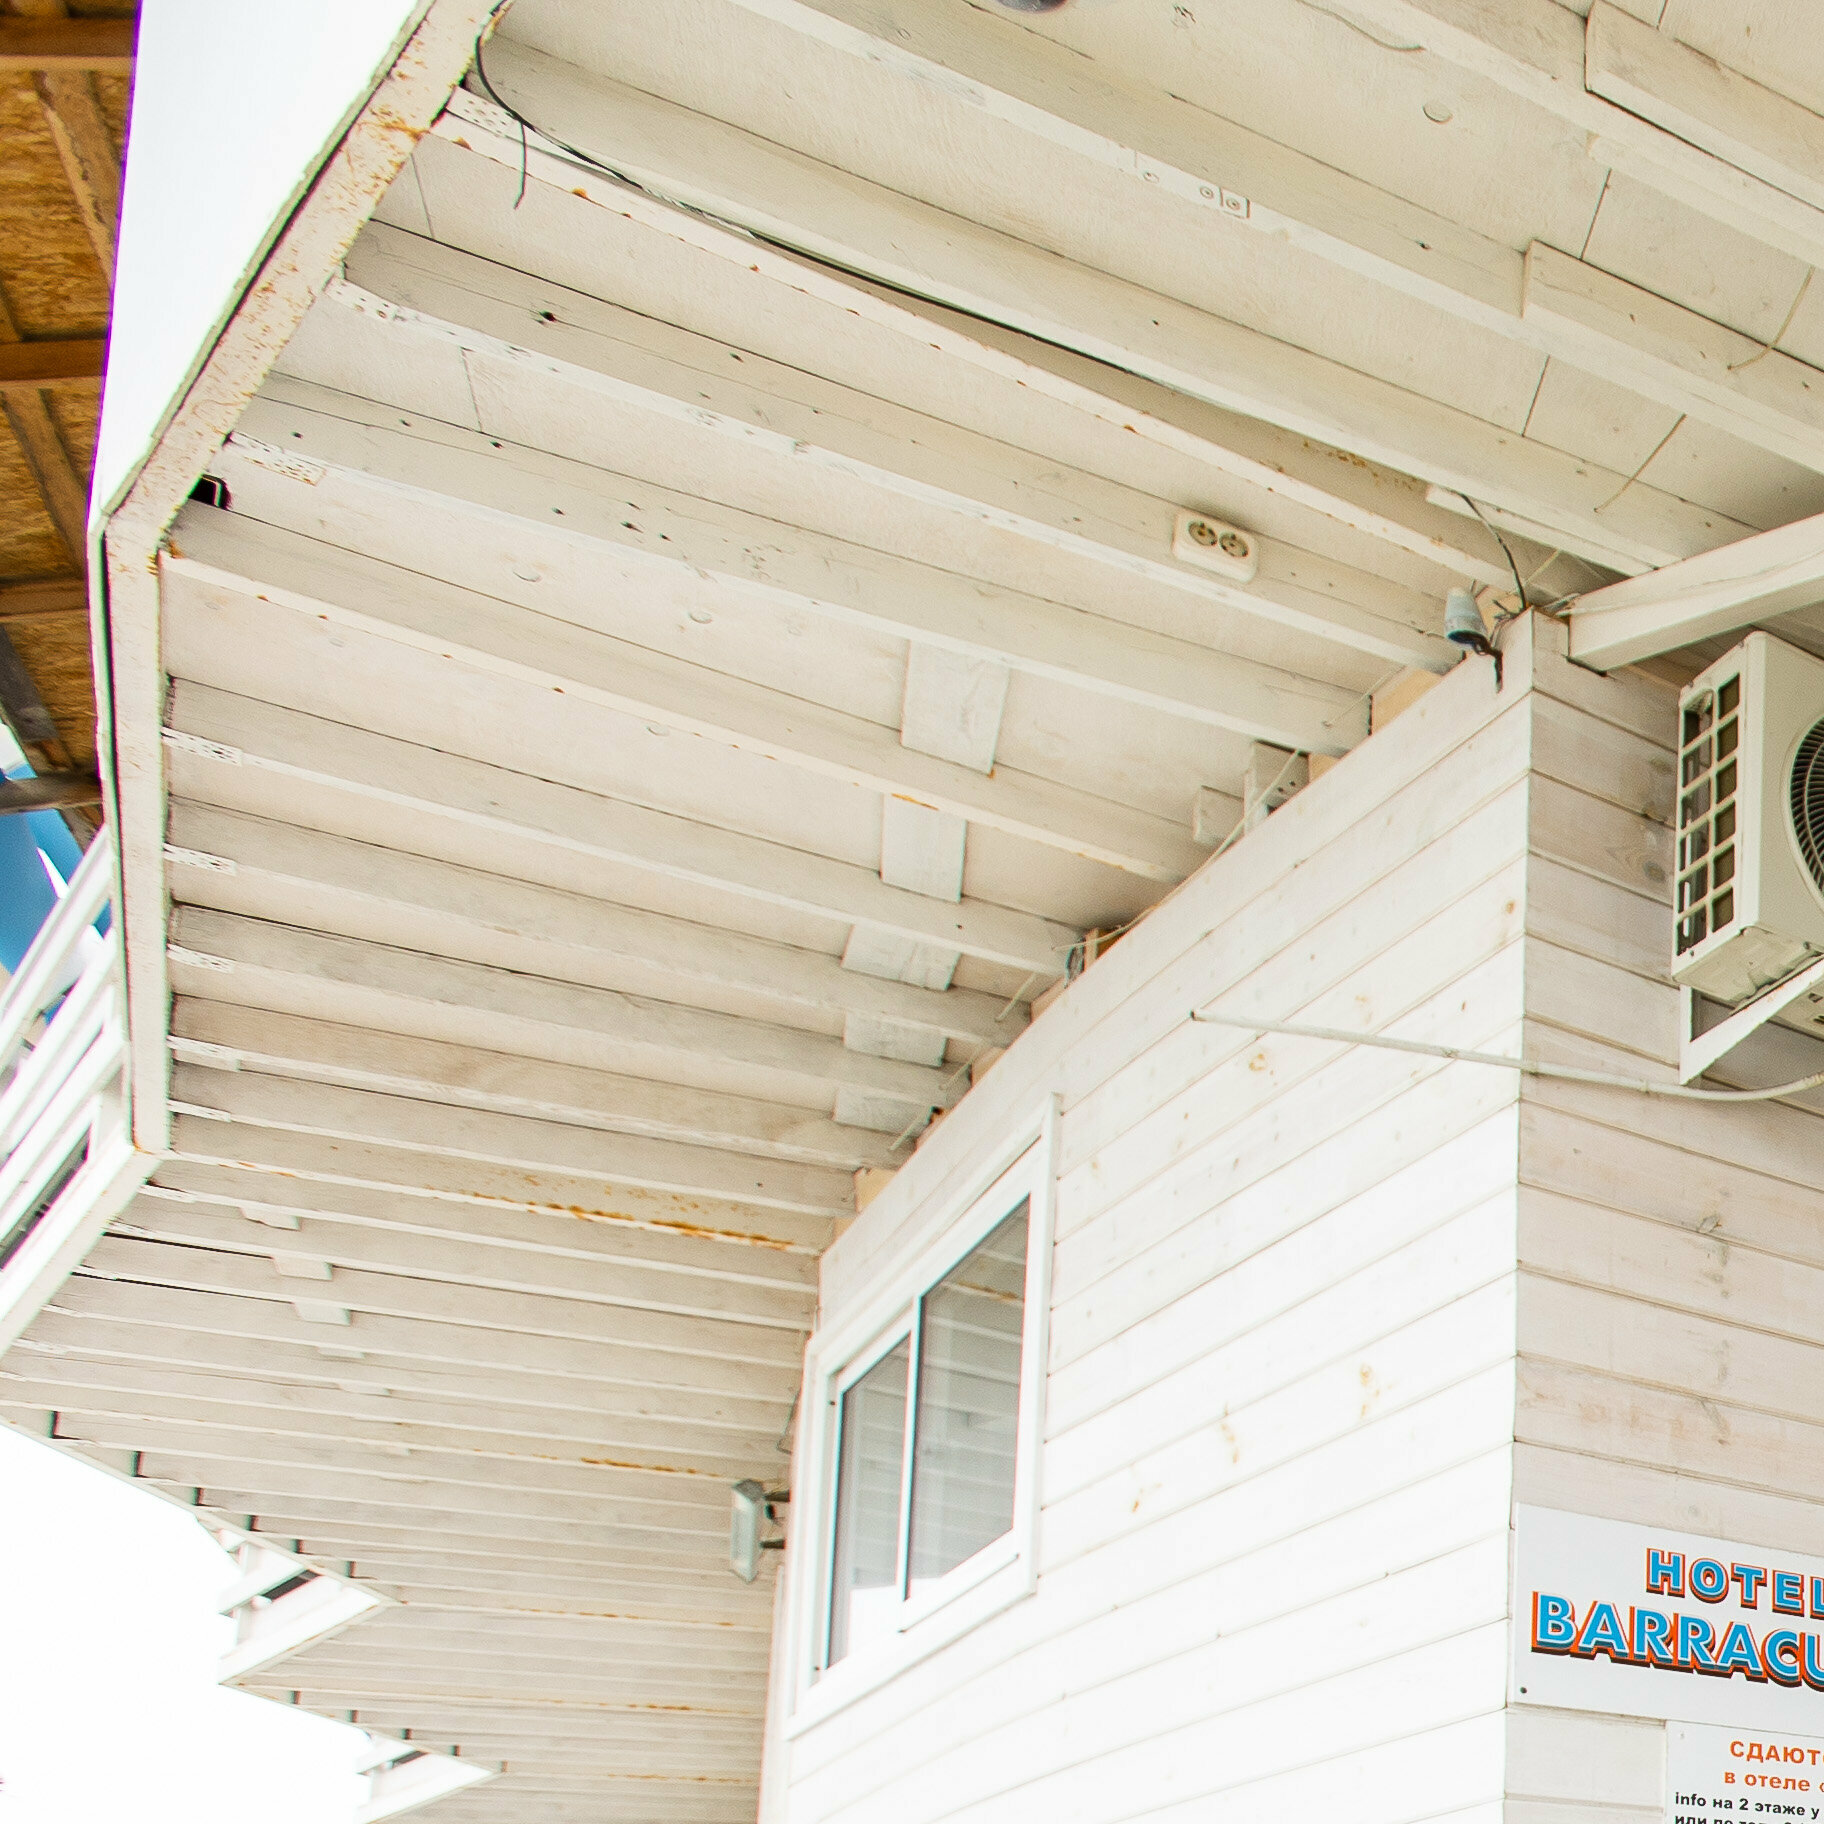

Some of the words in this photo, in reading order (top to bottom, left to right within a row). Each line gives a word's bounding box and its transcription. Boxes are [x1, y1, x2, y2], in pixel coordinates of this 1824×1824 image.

[1724, 1770, 1736, 1785] в
[1744, 1774, 1811, 1792] отеле
[1675, 1792, 1707, 1808] info
[1712, 1798, 1734, 1812] на
[1739, 1797, 1749, 1812] 2
[1754, 1802, 1806, 1817] этаже
[1810, 1807, 1820, 1821] у
